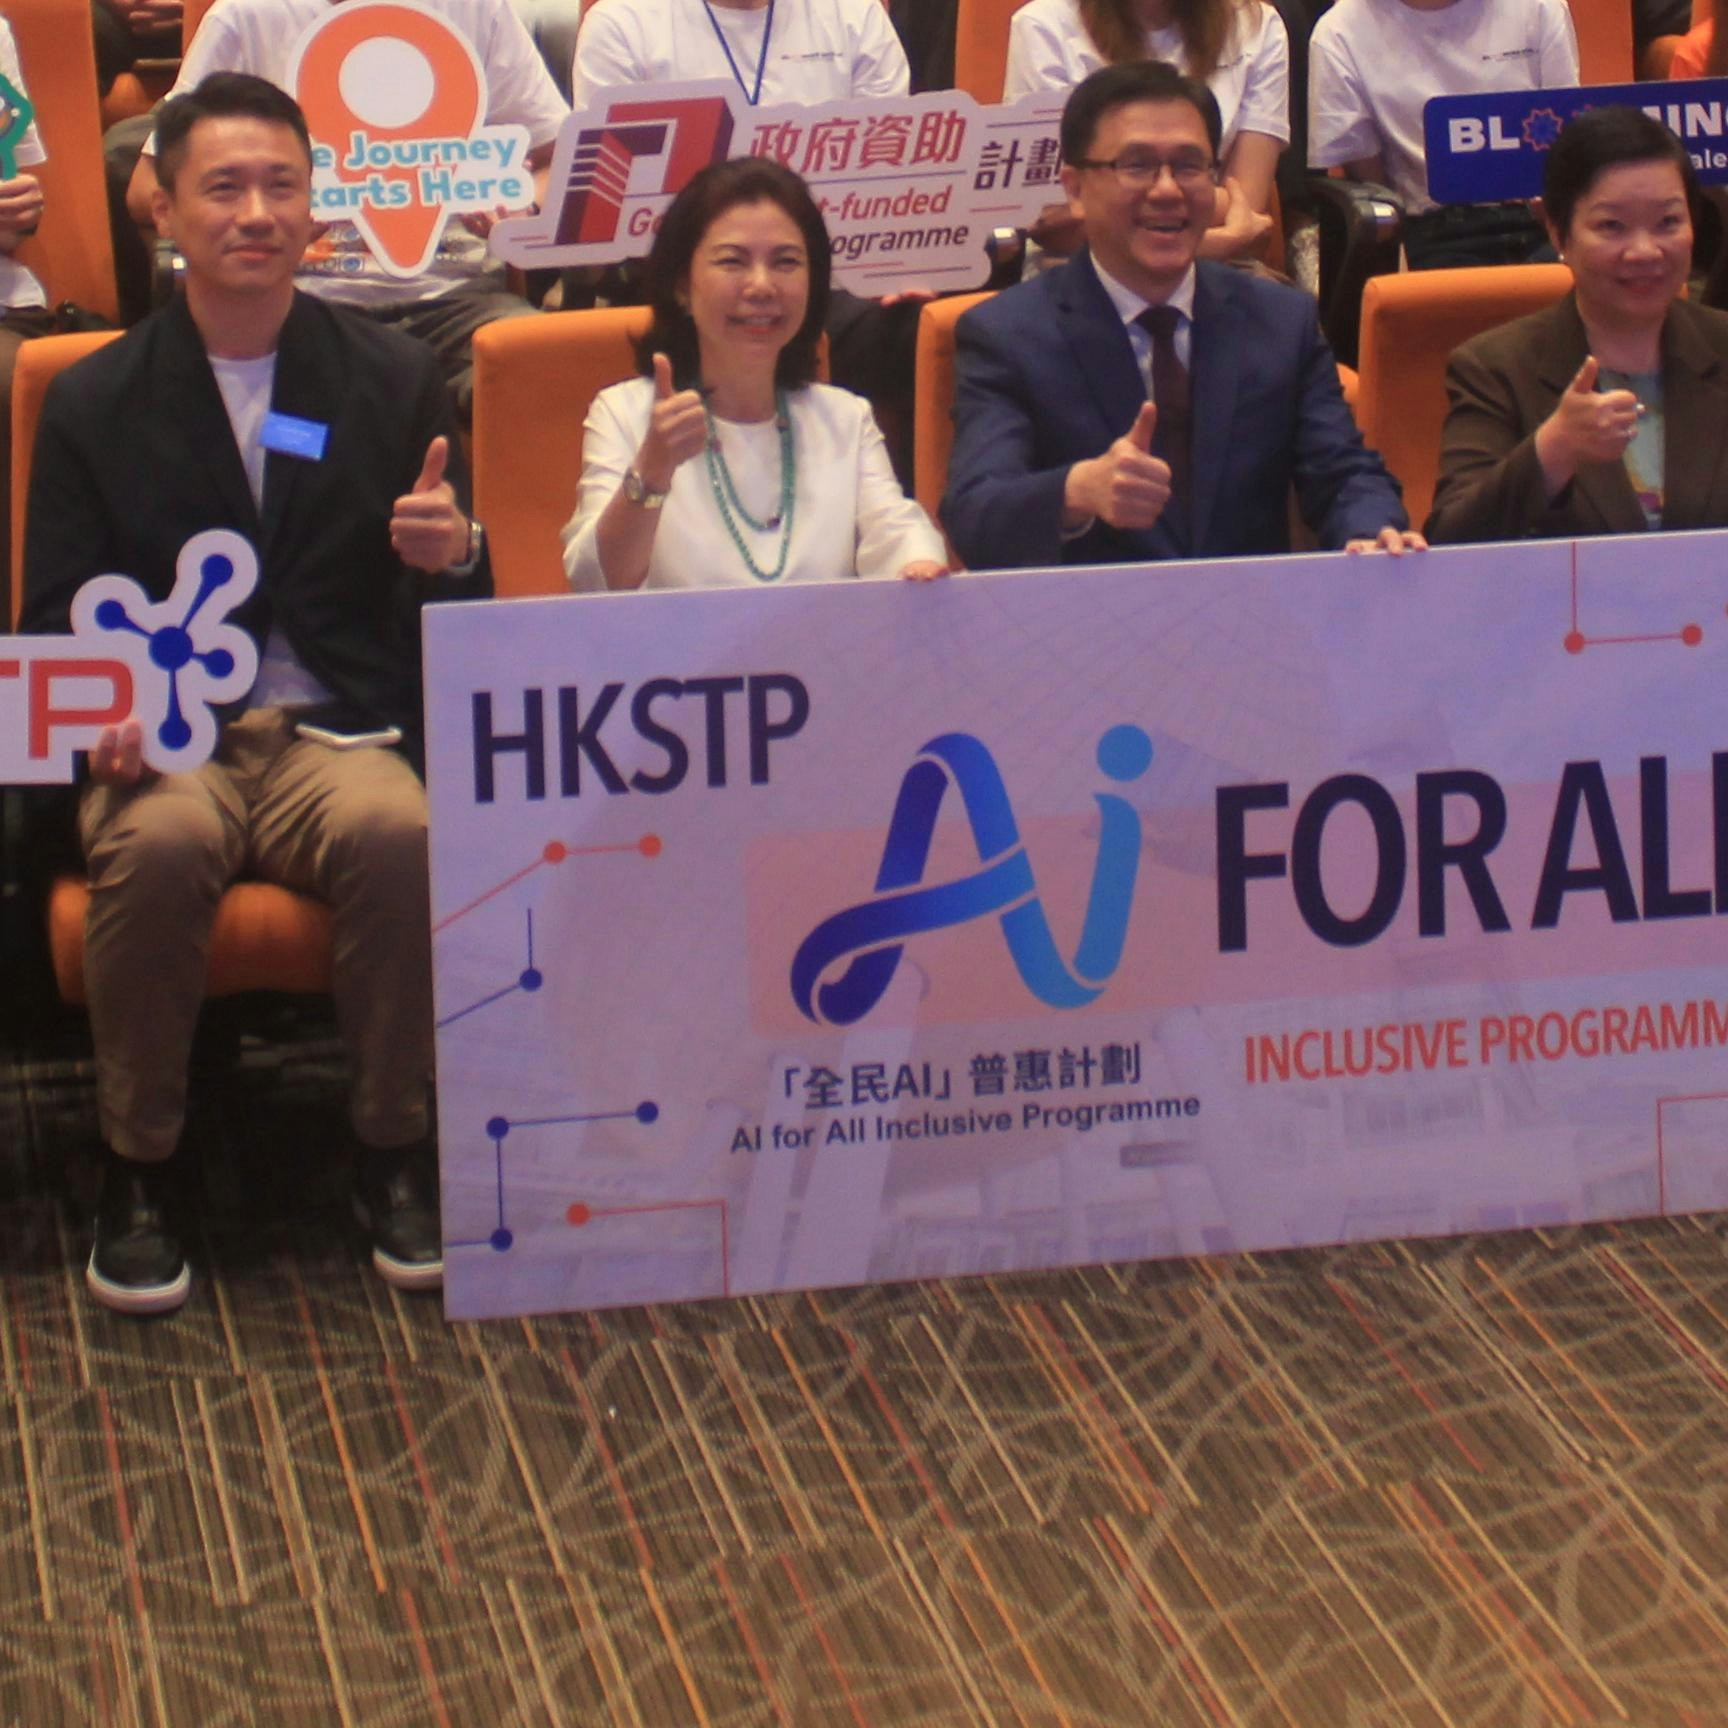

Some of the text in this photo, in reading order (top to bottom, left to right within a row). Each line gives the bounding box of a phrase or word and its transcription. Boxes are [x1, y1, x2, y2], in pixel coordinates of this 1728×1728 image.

[344, 134, 518, 172] Journey
[749, 111, 966, 176] 政府資助
[421, 167, 522, 206] Here
[470, 672, 811, 804] HKSTP
[1214, 771, 1510, 954] FOR
[1243, 1022, 1469, 1085] INCLUSIVE
[728, 1094, 1202, 1156] AI for All Inclusive Programme
